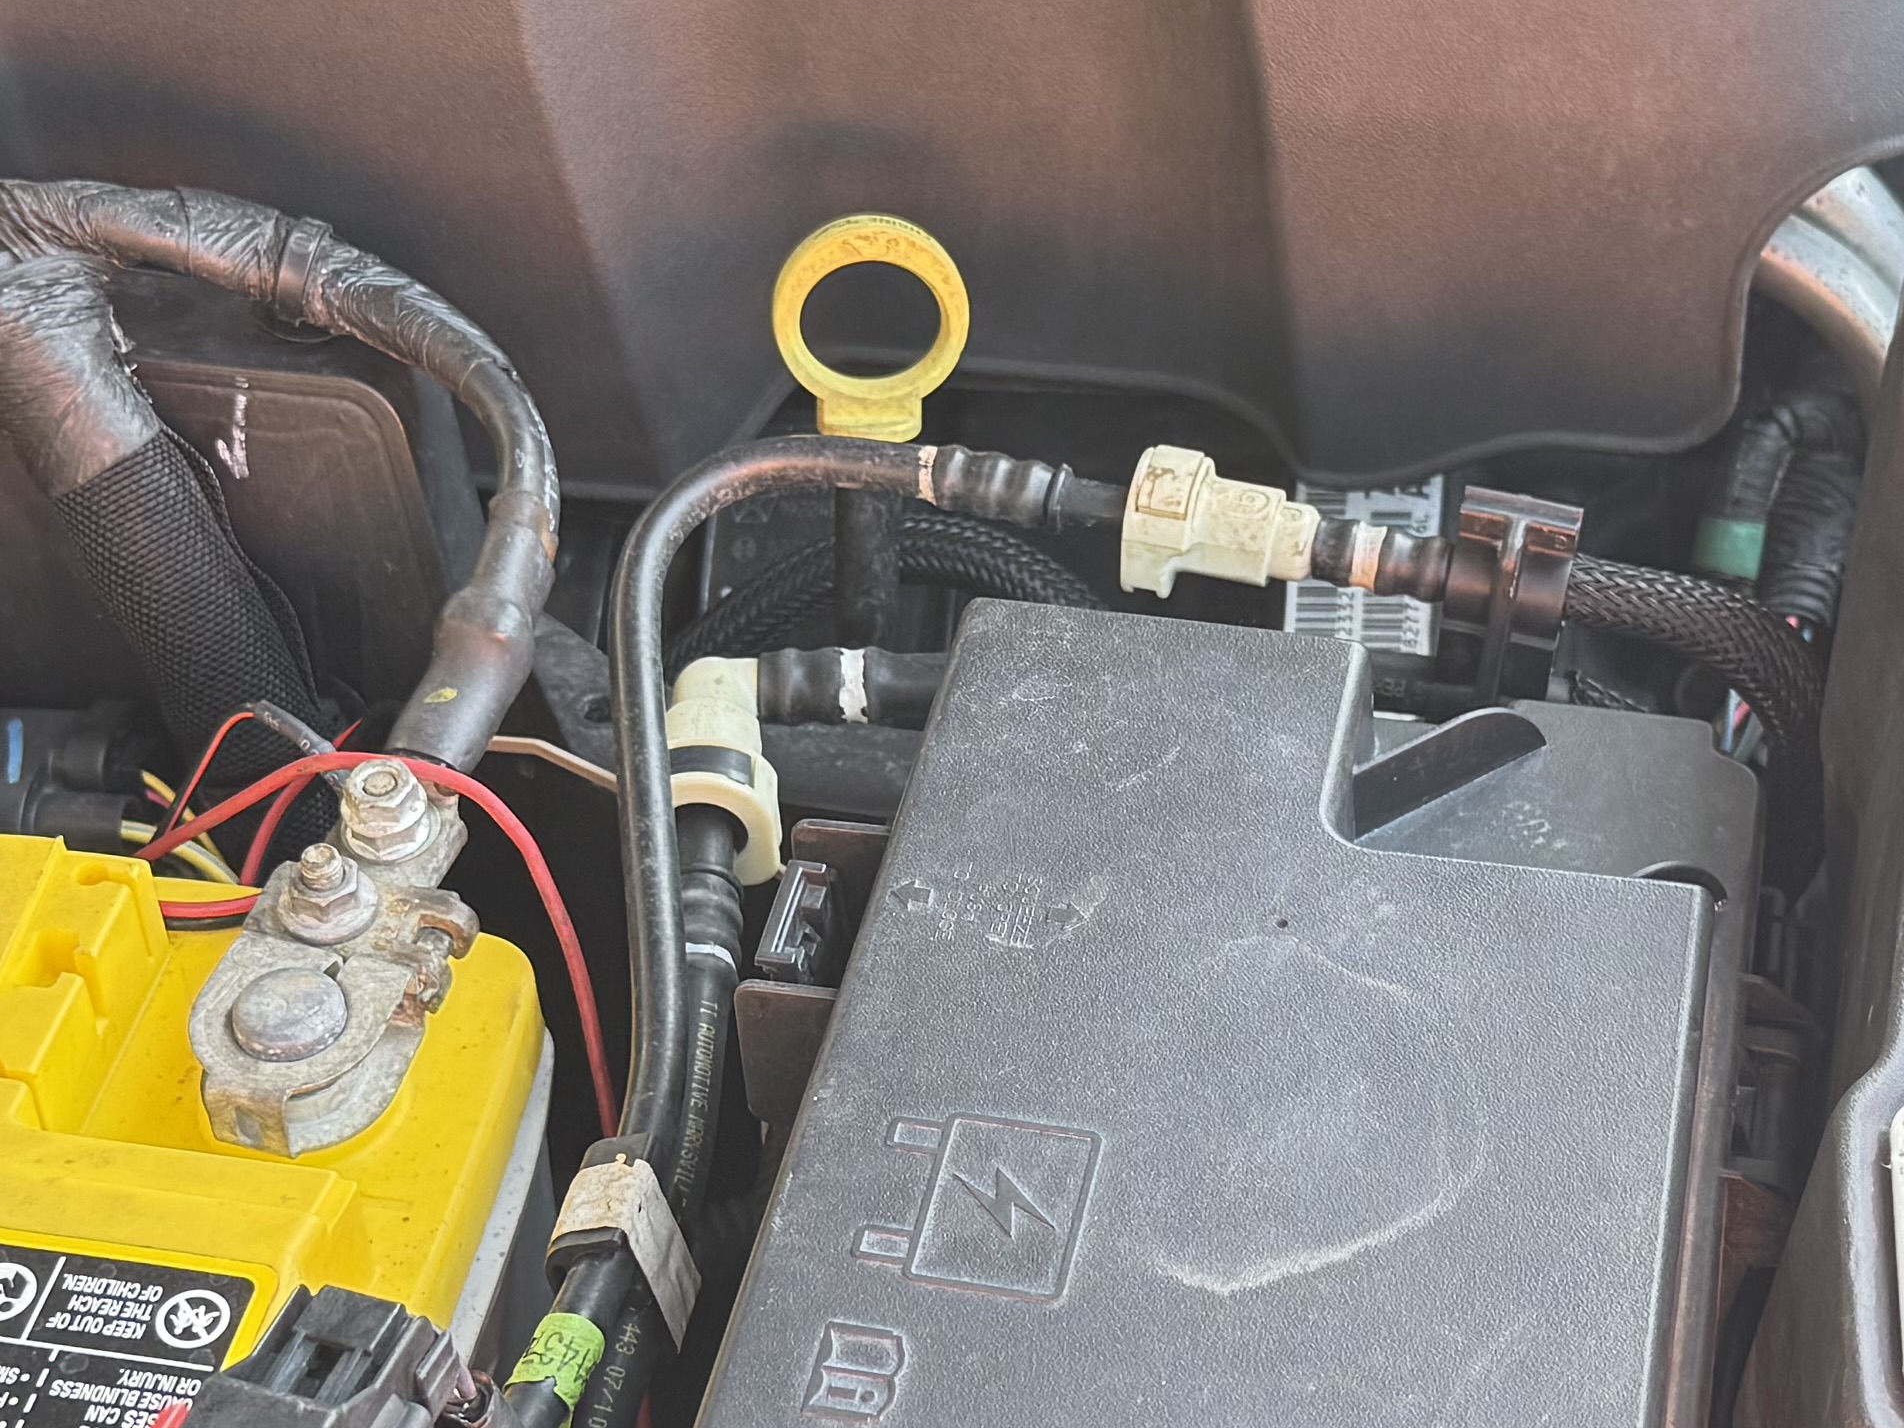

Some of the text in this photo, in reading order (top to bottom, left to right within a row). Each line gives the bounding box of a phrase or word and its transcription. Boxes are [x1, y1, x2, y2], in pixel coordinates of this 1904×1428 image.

[690, 1023, 714, 1111] AUTOMOTIVE
[61, 1272, 163, 1302] OF CHILDREN.
[66, 1293, 161, 1321] THE REACH
[44, 1310, 146, 1339] KEEP OUT OF
